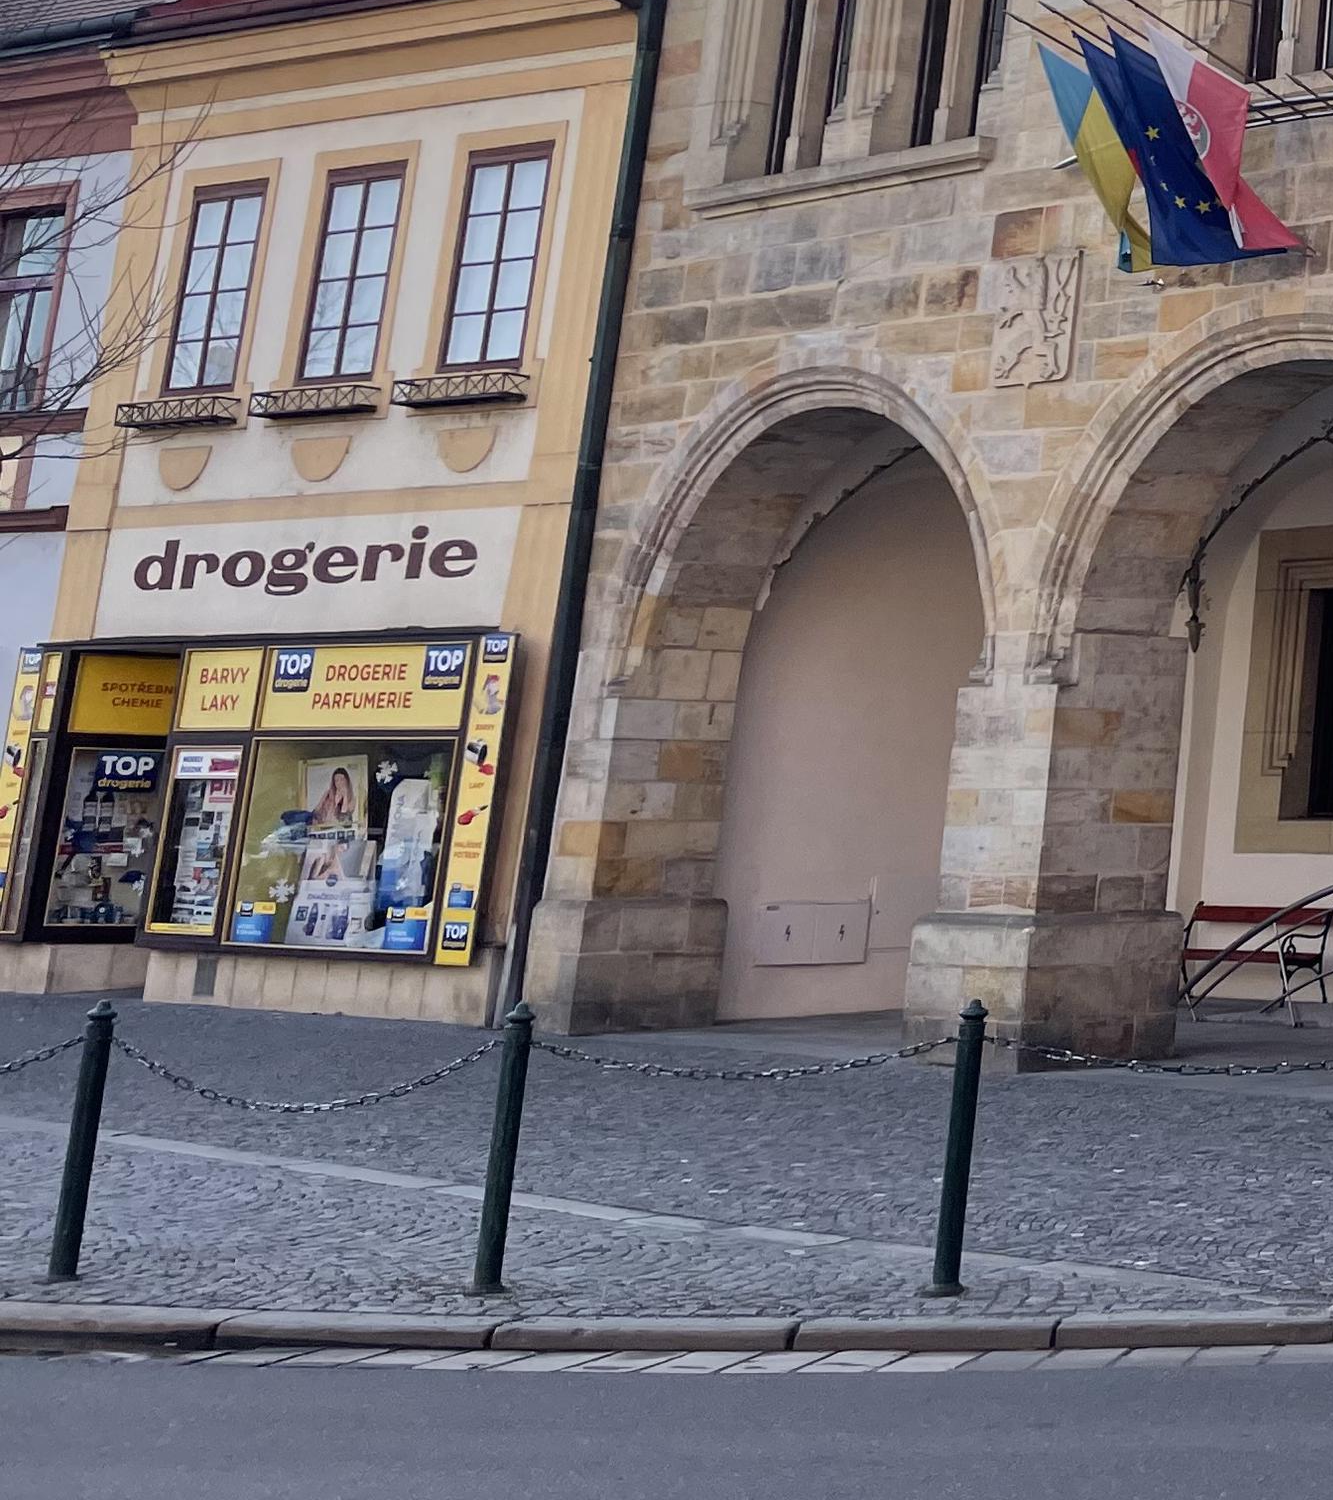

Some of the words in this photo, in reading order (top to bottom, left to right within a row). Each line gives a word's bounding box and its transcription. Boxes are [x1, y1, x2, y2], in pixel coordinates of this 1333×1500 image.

[134, 525, 477, 596] drogerie
[487, 639, 508, 652] TOP
[279, 654, 312, 675] TOP
[428, 650, 464, 672] TOP
[199, 667, 250, 685] BARVY
[325, 663, 408, 682] DROGERIE
[101, 681, 175, 695] SPOTŘEBN
[112, 697, 164, 709] CHEMIE
[200, 695, 240, 712] LAKY
[311, 691, 413, 710] PARFUMERIE
[101, 755, 155, 776] TOP
[97, 777, 152, 790] drogerie
[445, 925, 468, 940] TOP
